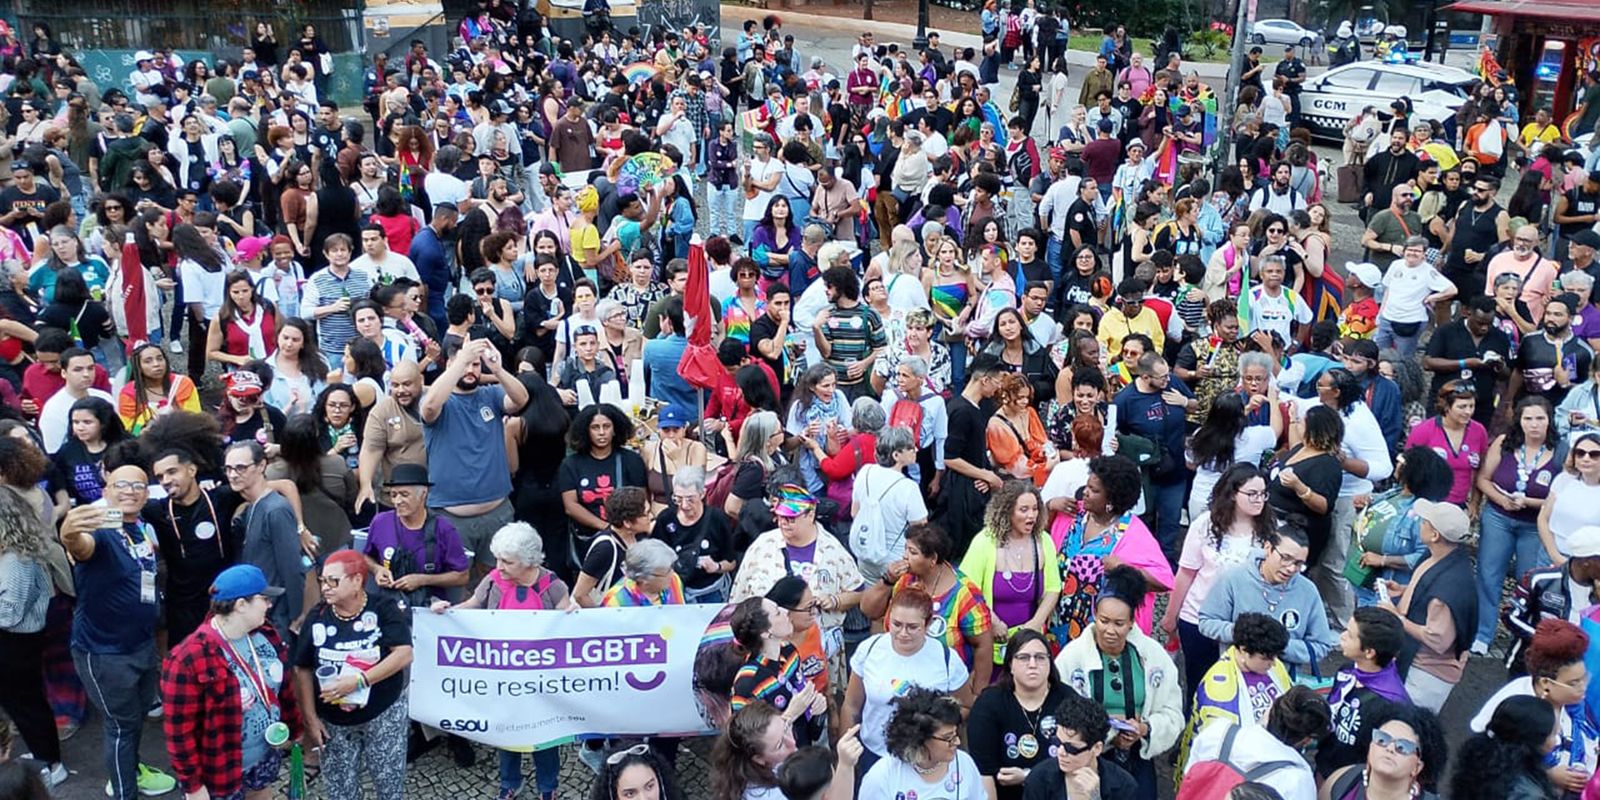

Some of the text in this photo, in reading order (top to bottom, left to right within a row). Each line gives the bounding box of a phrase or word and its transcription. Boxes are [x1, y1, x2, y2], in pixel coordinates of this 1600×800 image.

[1314, 99, 1346, 110] GCM
[440, 637, 661, 666] Velhices LGBT+
[441, 670, 620, 698] que resistem!
